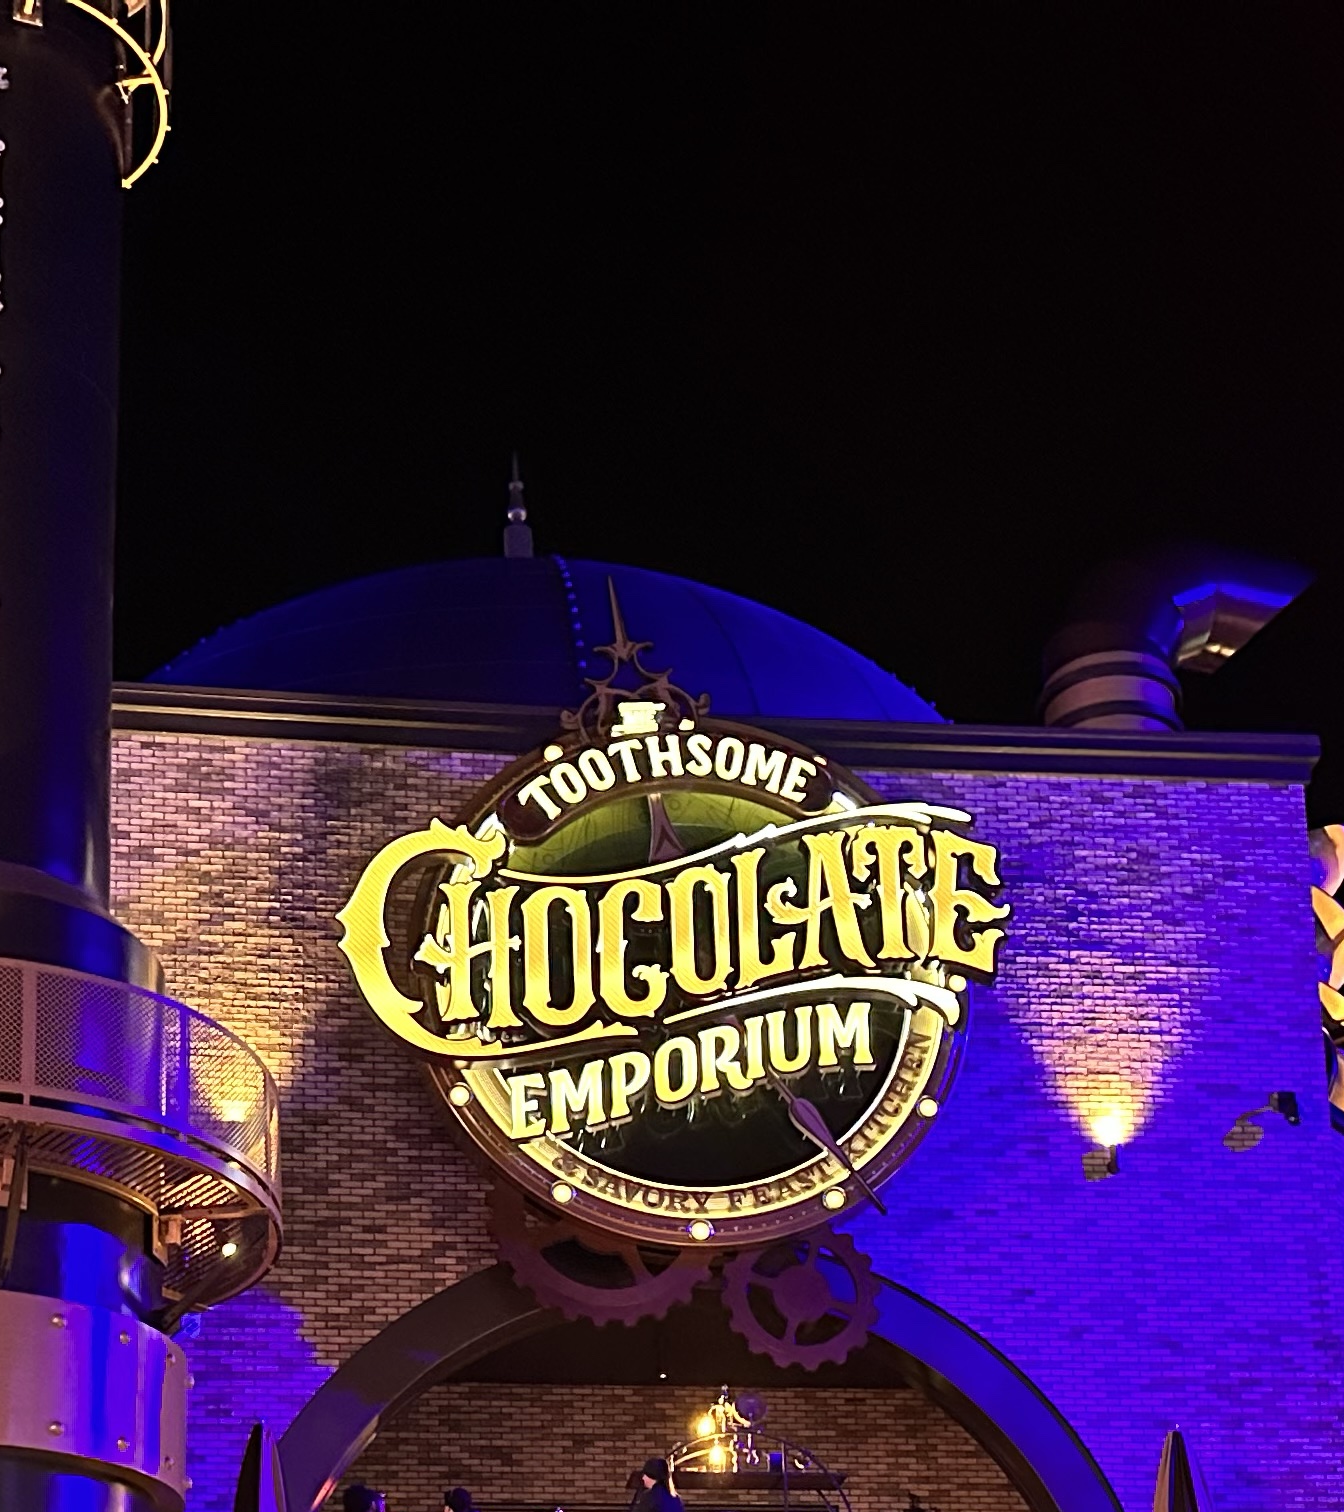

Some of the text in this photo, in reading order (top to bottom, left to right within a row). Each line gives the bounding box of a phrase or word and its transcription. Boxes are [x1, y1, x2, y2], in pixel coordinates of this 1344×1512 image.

[517, 733, 816, 821] TOOTHSOME
[335, 817, 1011, 1057] CHOCOLATE
[507, 1002, 874, 1141] EMPORIUM
[581, 1164, 713, 1214] SAVORY
[728, 1158, 834, 1211] FEAST
